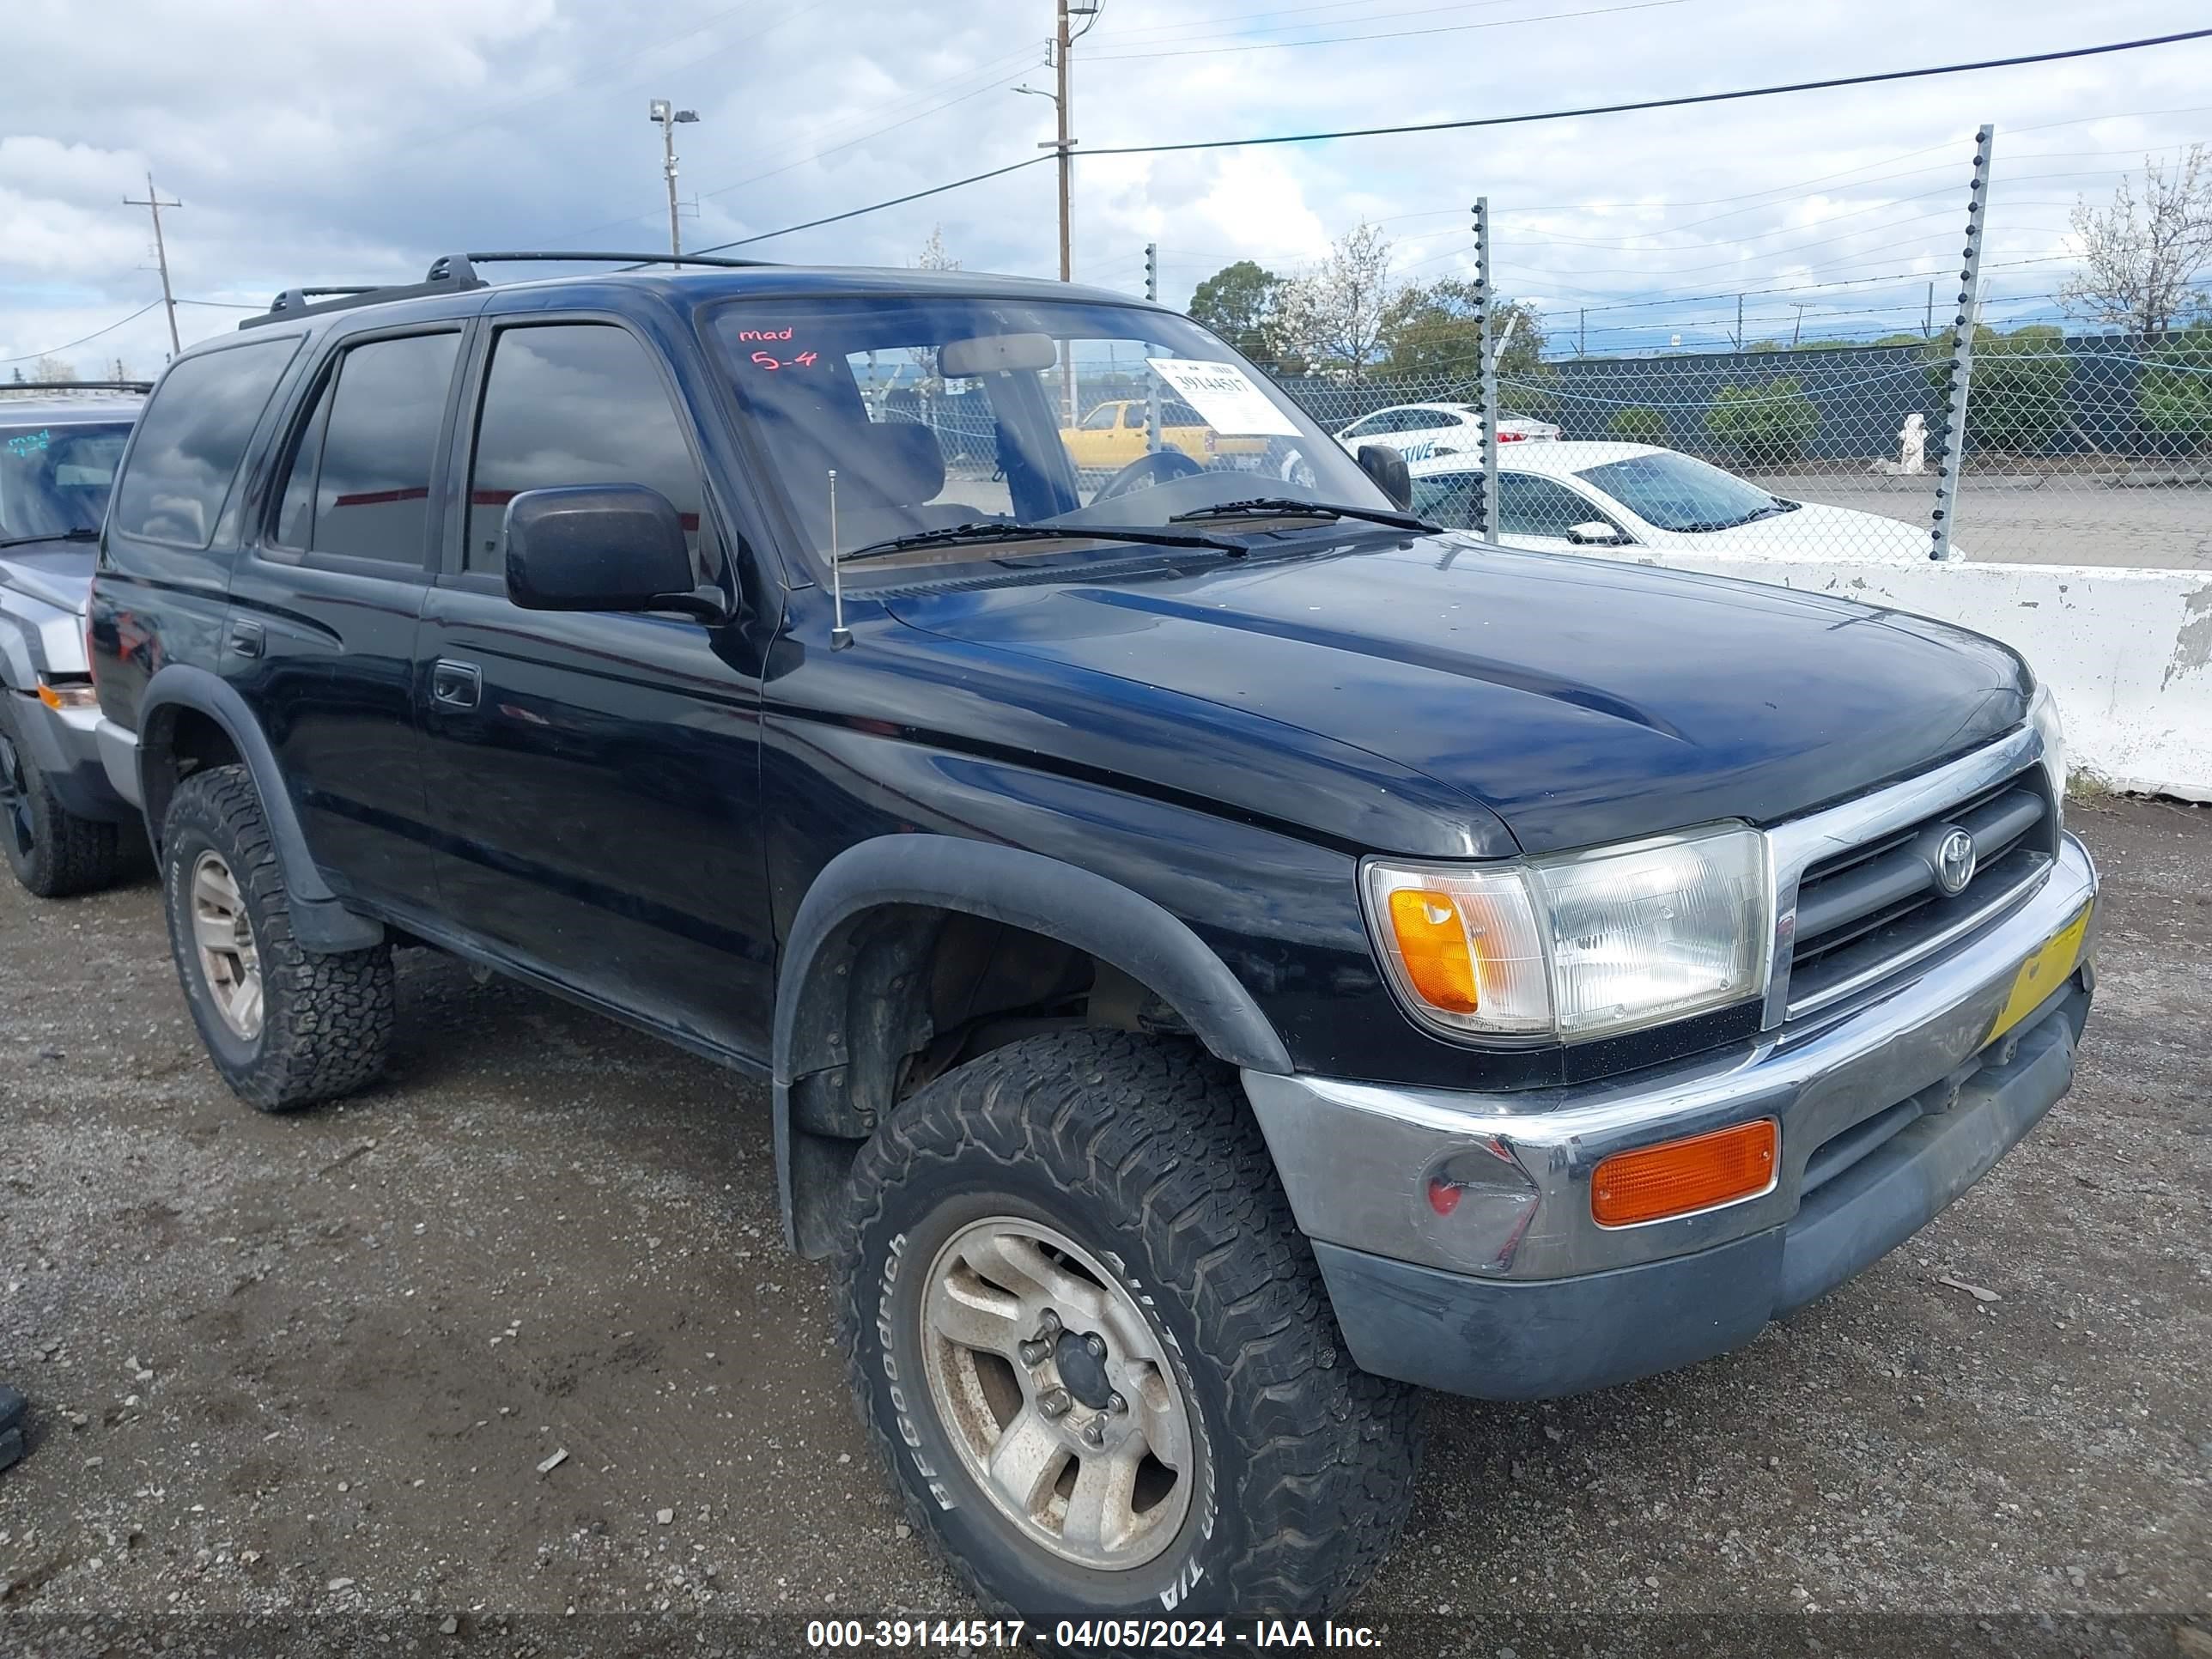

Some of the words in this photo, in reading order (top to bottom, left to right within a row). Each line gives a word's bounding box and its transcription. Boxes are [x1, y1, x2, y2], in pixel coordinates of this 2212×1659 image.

[739, 327, 793, 342] mad
[750, 351, 817, 370] 5-4
[1175, 376, 1249, 392] 39144517
[877, 1234, 956, 1510] BFGoodrich
